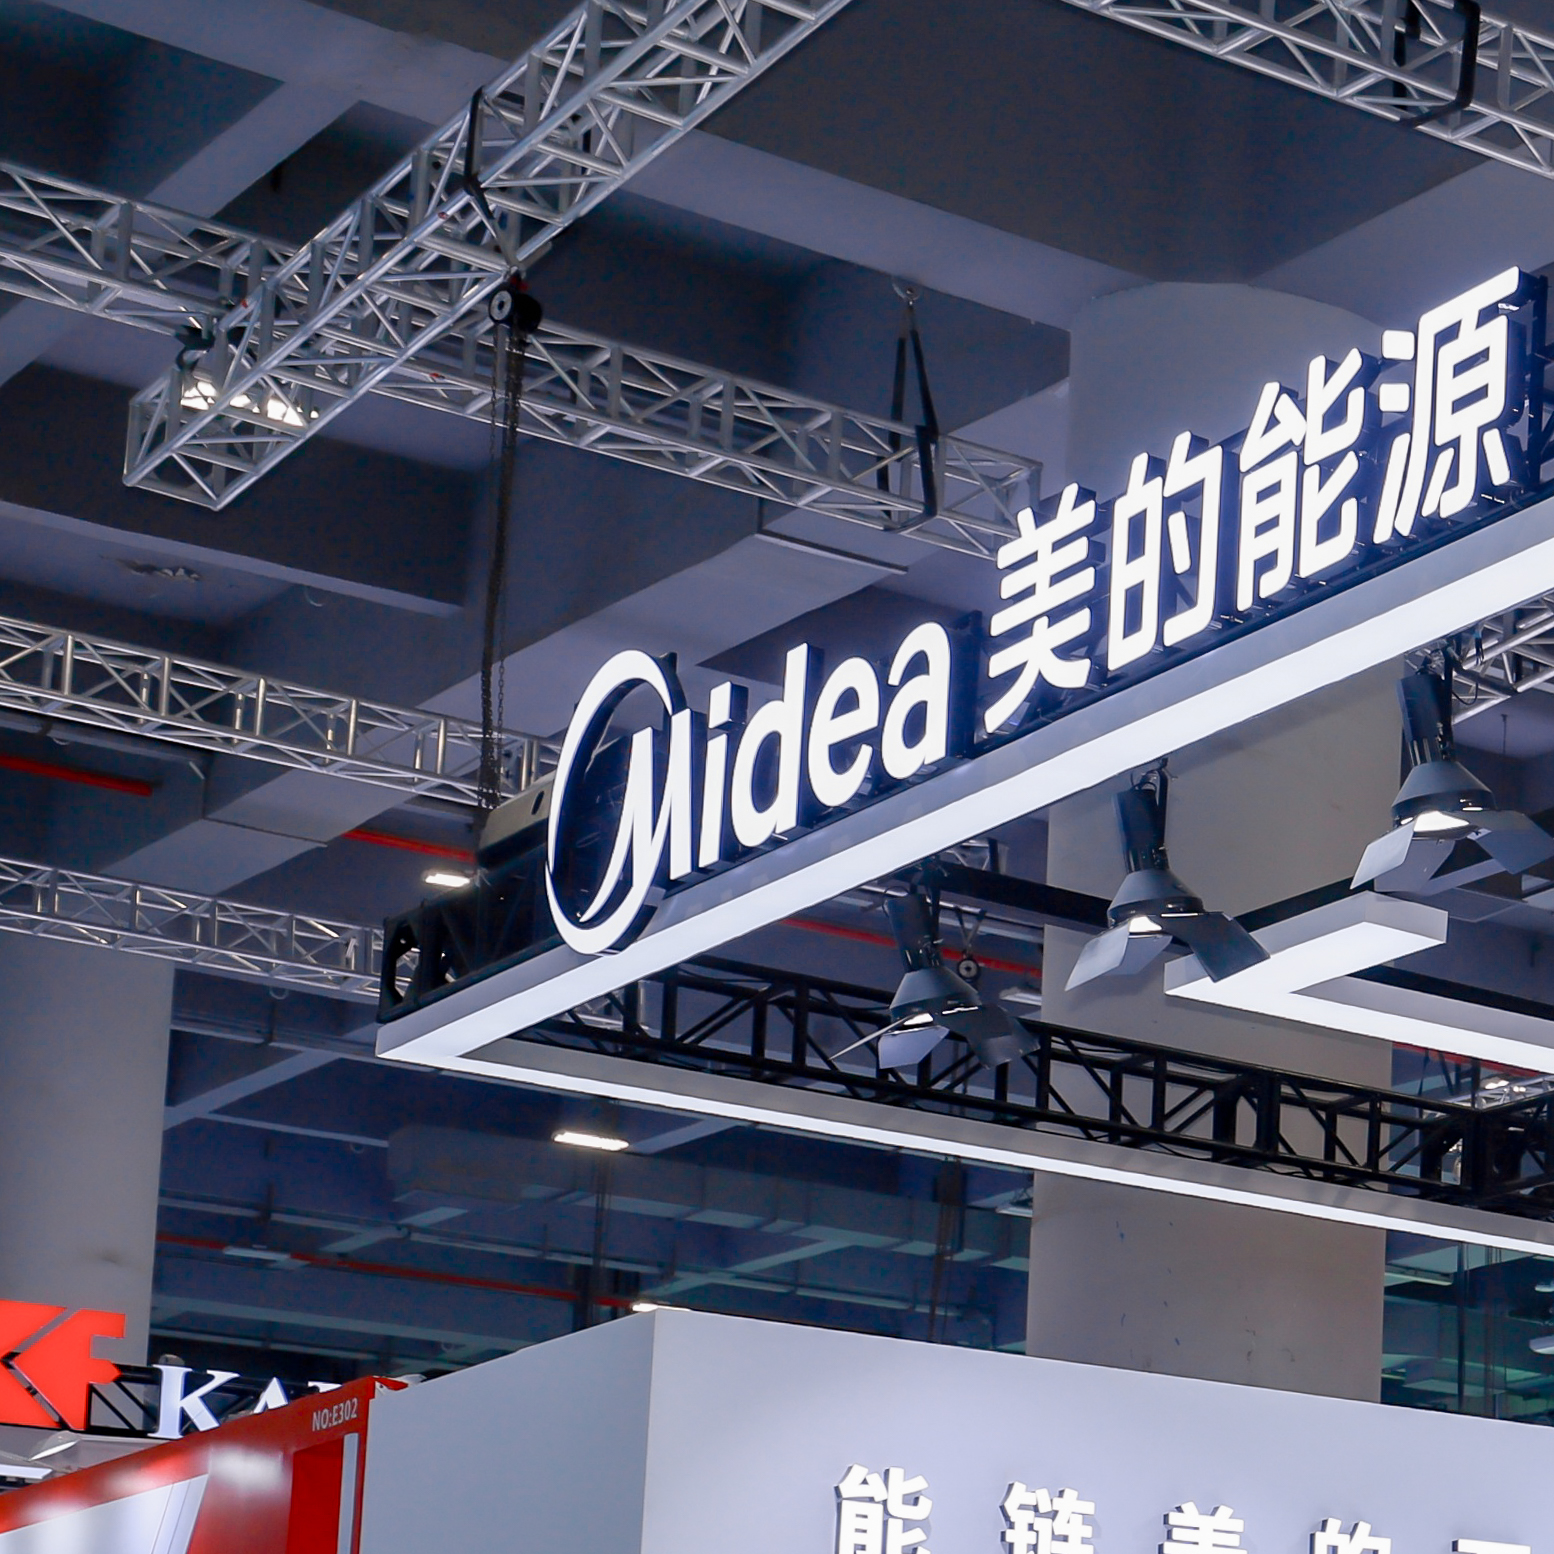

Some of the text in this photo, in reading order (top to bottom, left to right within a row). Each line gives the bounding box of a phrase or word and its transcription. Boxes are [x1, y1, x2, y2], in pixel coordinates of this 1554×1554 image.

[545, 265, 1521, 955] Midea 美的能源
[312, 1397, 358, 1432] NO:E302
